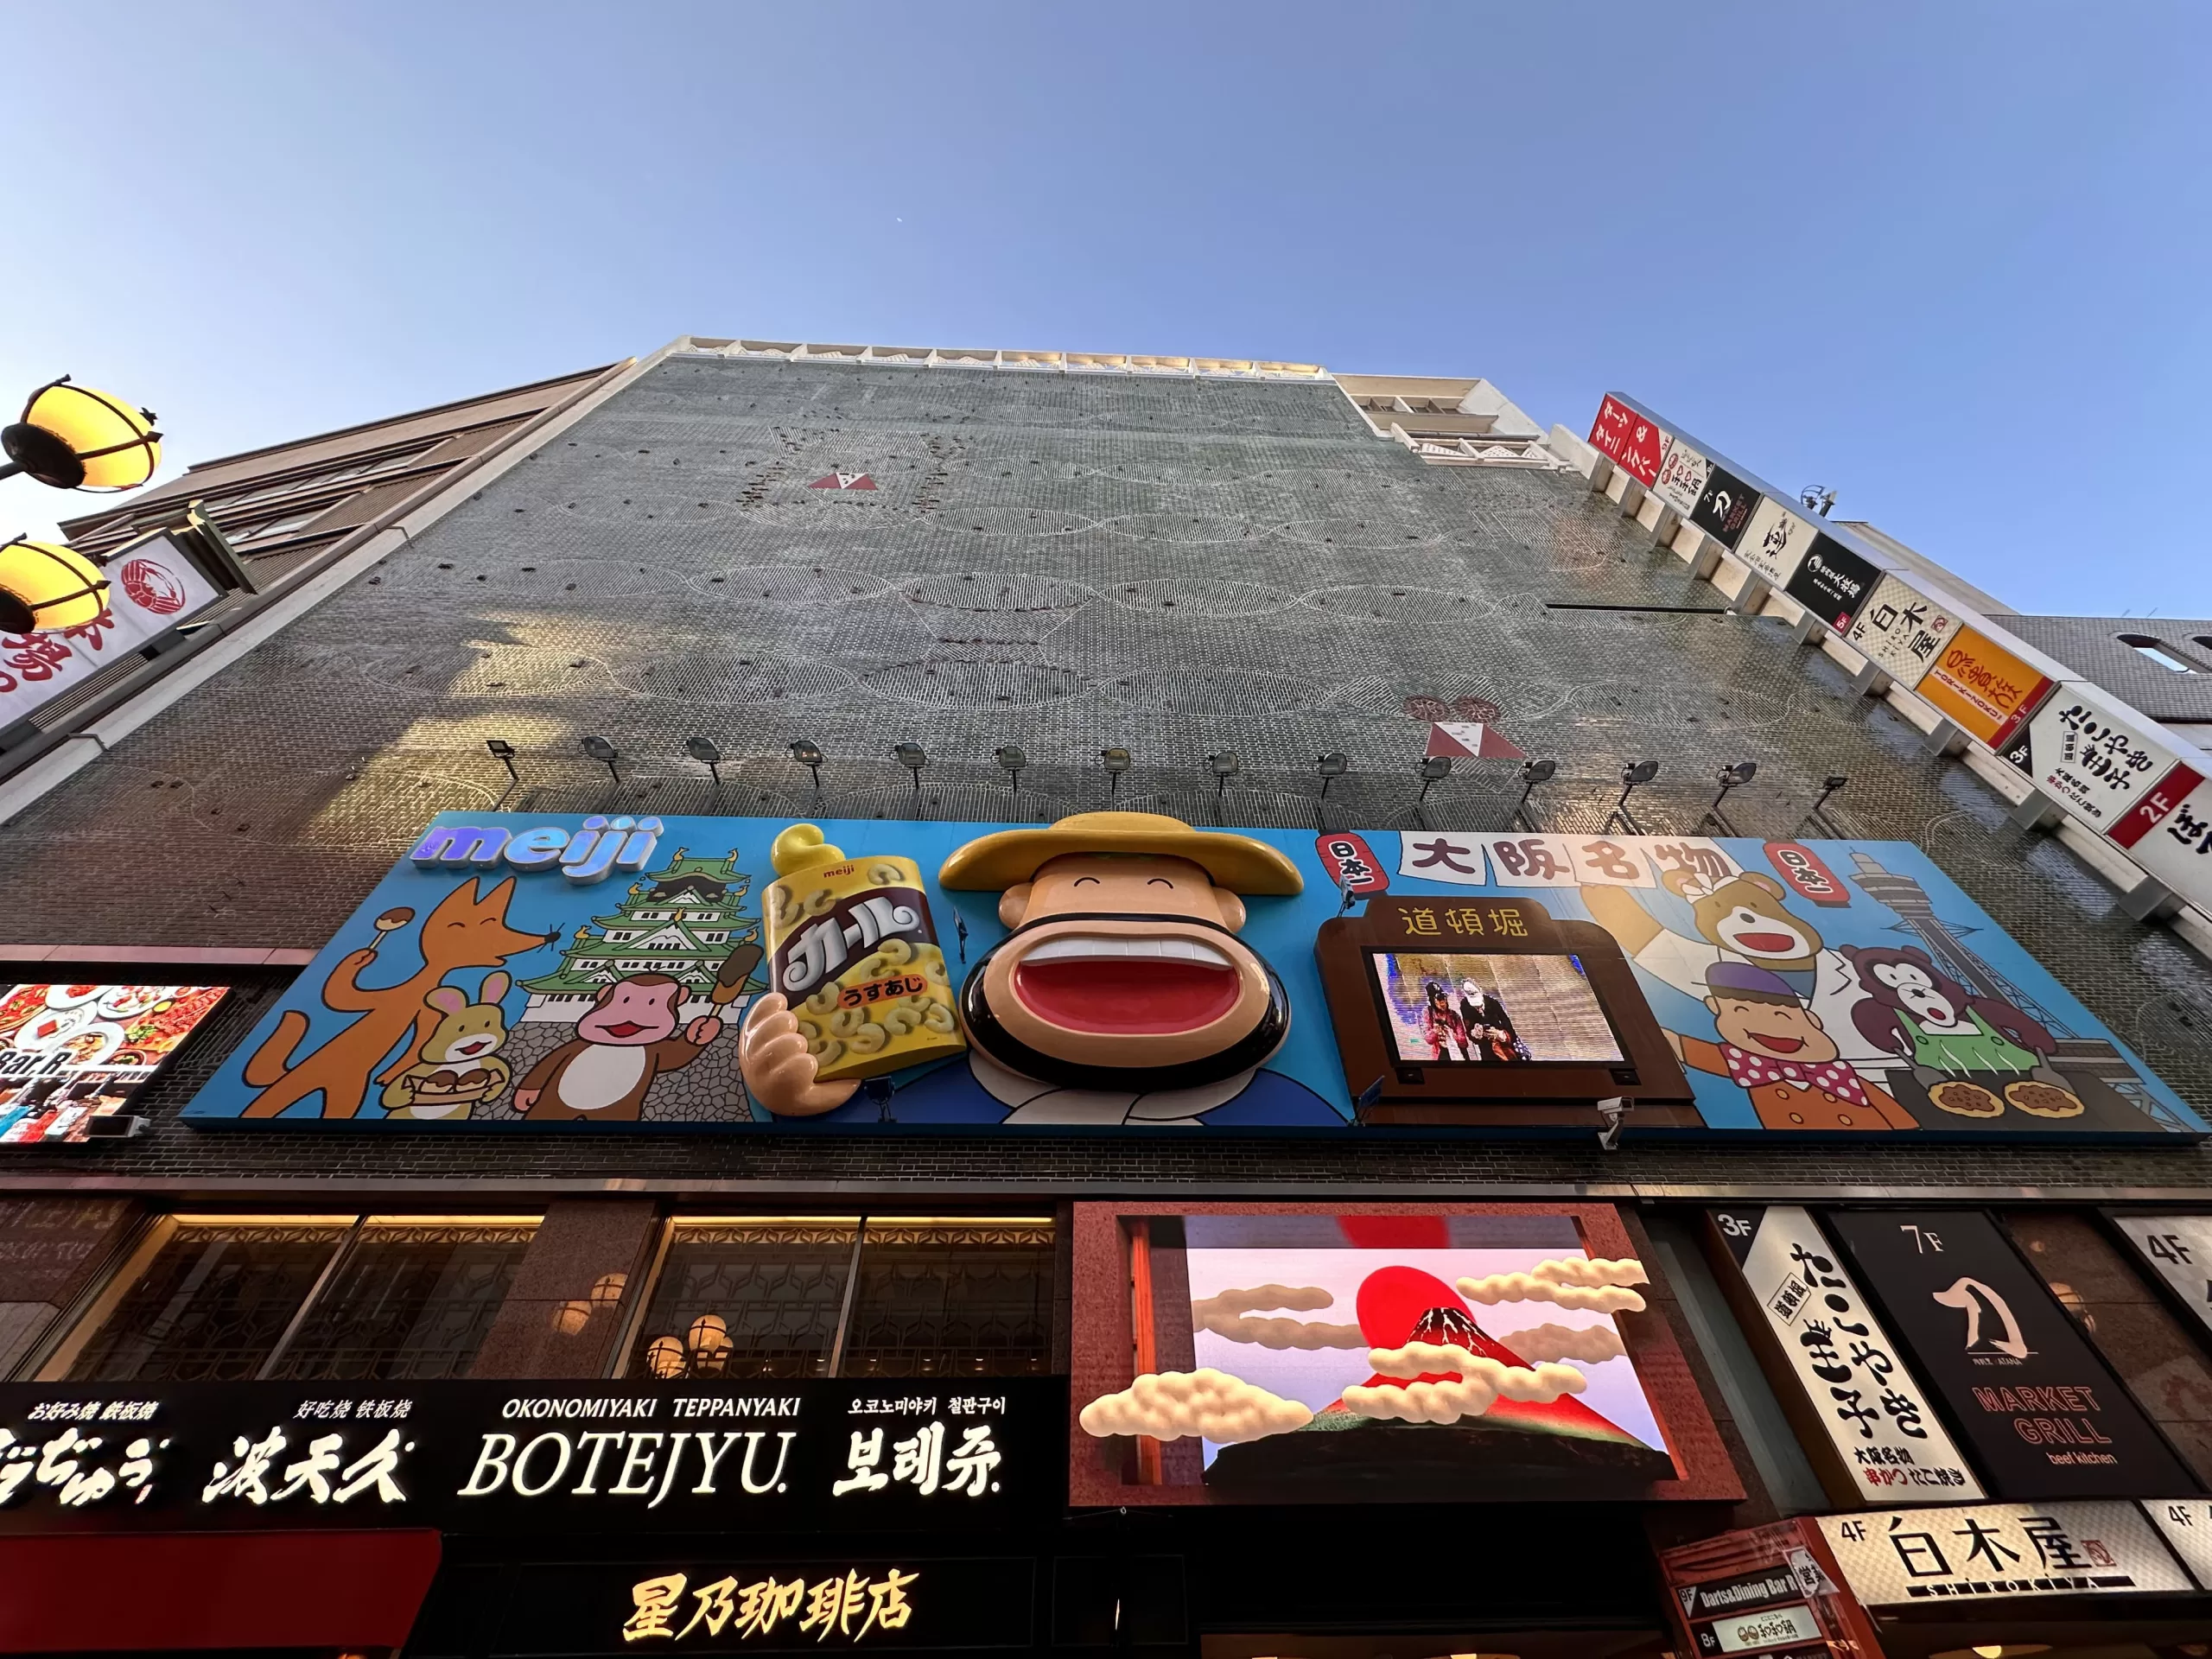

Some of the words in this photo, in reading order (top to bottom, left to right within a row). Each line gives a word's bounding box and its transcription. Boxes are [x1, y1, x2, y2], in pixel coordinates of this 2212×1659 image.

[1836, 616, 1848, 630] 5F
[1853, 621, 1866, 641] 4F
[1870, 601, 1941, 663] 白木屋
[1935, 669, 1999, 719] TORIKIZOKU
[2011, 703, 2028, 724] 3F
[2058, 705, 2154, 772] たこやき
[2010, 745, 2030, 764] 3F
[2139, 791, 2171, 824] 2F
[409, 816, 664, 885] meiji
[1328, 841, 1375, 885] 日本一
[1412, 838, 1731, 880] 大阪名物
[823, 865, 855, 879] meiji
[1777, 849, 1834, 893] 日本一
[1397, 906, 1529, 938] 道頓堀
[782, 896, 920, 991] カール
[842, 976, 924, 1007] うすあじ
[1718, 1214, 1751, 1236] 3F
[1900, 1224, 1943, 1255] 7F
[2146, 1235, 2193, 1264] 4F
[1789, 1243, 1928, 1440] たこやき
[27, 1401, 102, 1421] お好み焼
[99, 1400, 160, 1421] 鉄板焼
[502, 1398, 658, 1419] OKONOMIYAKI
[673, 1397, 802, 1417] TEPPANYAKI
[848, 1396, 938, 1415] 오코노미야키
[947, 1396, 1006, 1415] 철판구이
[1972, 1386, 2101, 1412] MARKET
[2013, 1418, 2113, 1445] GRILL
[1853, 1446, 1915, 1465] 大阪名物
[2046, 1452, 2076, 1465] beef
[2074, 1452, 2118, 1465] kitchen
[2168, 1506, 2194, 1527] 4F
[1840, 1521, 1867, 1543] 4F
[1888, 1516, 2093, 1578] 白木屋
[622, 1567, 919, 1643] 星乃珈琲店
[1680, 1588, 1694, 1603] 9F
[1700, 1581, 1769, 1608] Darts&Dining
[1768, 1576, 1789, 1598] Bar
[1700, 1633, 1716, 1648] 8F
